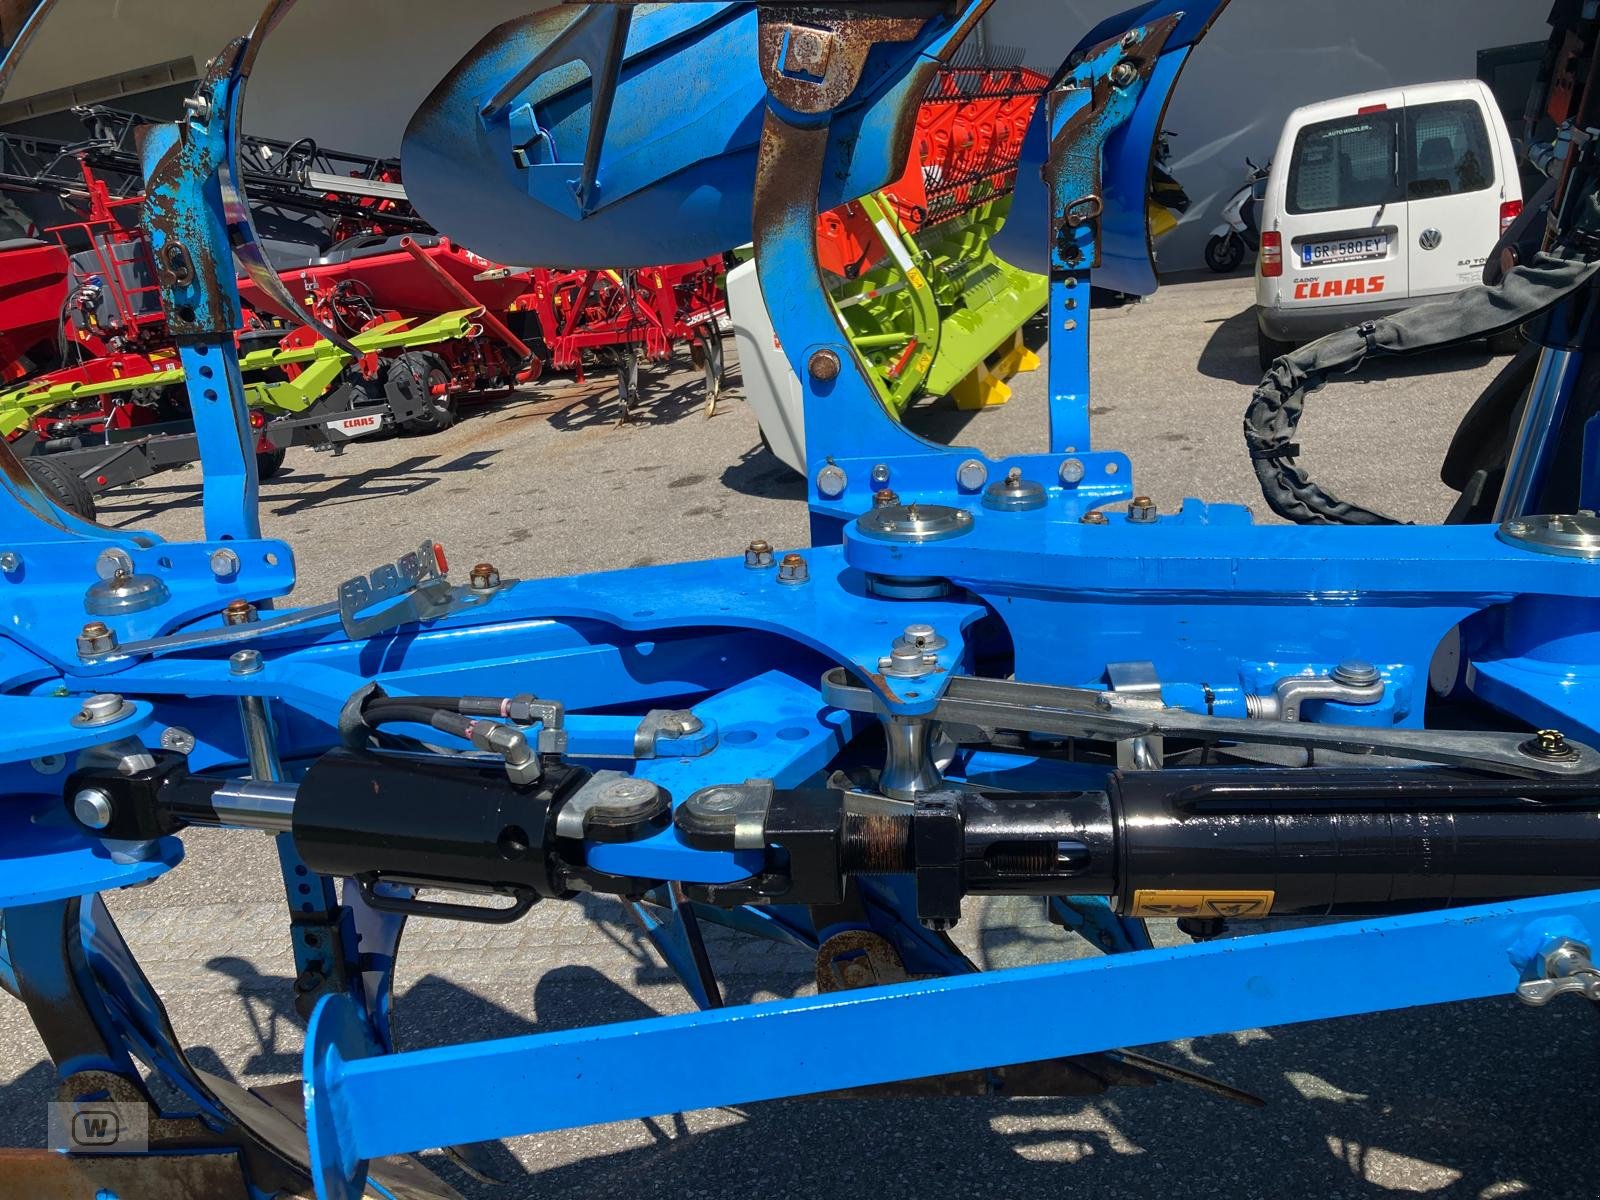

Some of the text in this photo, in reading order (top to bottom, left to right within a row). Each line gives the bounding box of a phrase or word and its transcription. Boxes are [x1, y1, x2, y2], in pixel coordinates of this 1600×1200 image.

[1314, 245, 1330, 258] GR
[1339, 241, 1363, 255] 580
[1365, 238, 1381, 252] EY
[1294, 275, 1385, 299] CLAAS
[343, 417, 374, 428] CLAAS
